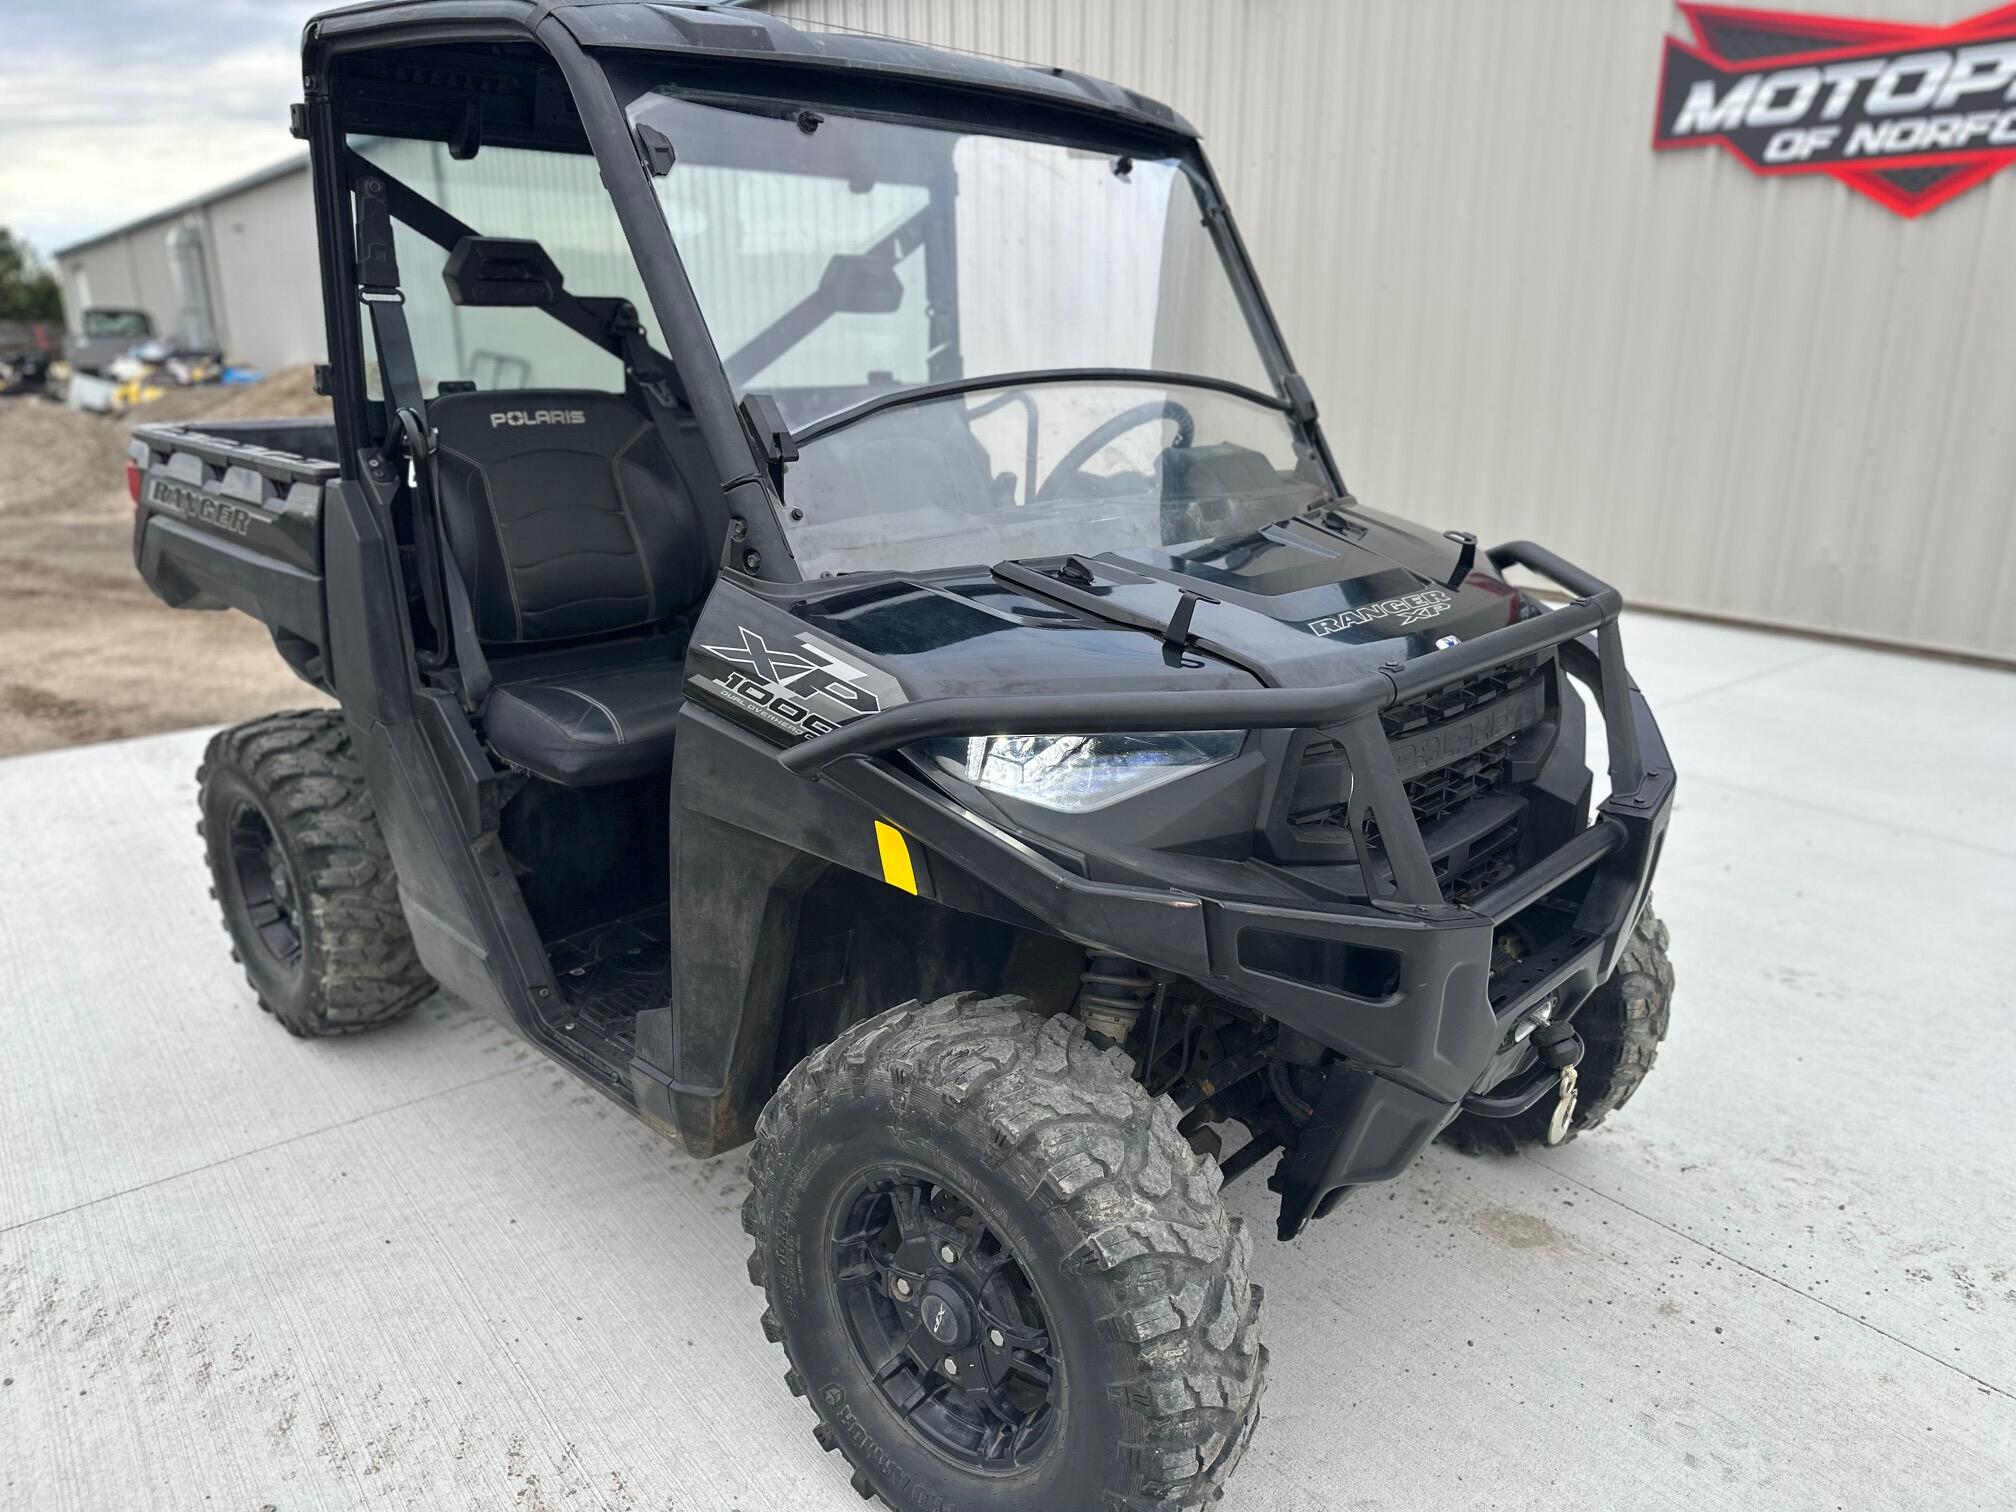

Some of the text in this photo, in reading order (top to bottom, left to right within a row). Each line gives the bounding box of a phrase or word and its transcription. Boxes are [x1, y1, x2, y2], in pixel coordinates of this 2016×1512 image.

[1672, 41, 2016, 136] MOTOP
[1763, 125, 1842, 162] OF
[490, 410, 586, 428] POLARIS
[152, 480, 251, 536] RANGER
[1308, 590, 1451, 637] RANGER
[1397, 603, 1451, 626] XP
[700, 625, 881, 714] XP
[720, 690, 804, 735] DUAL OVERHEAD
